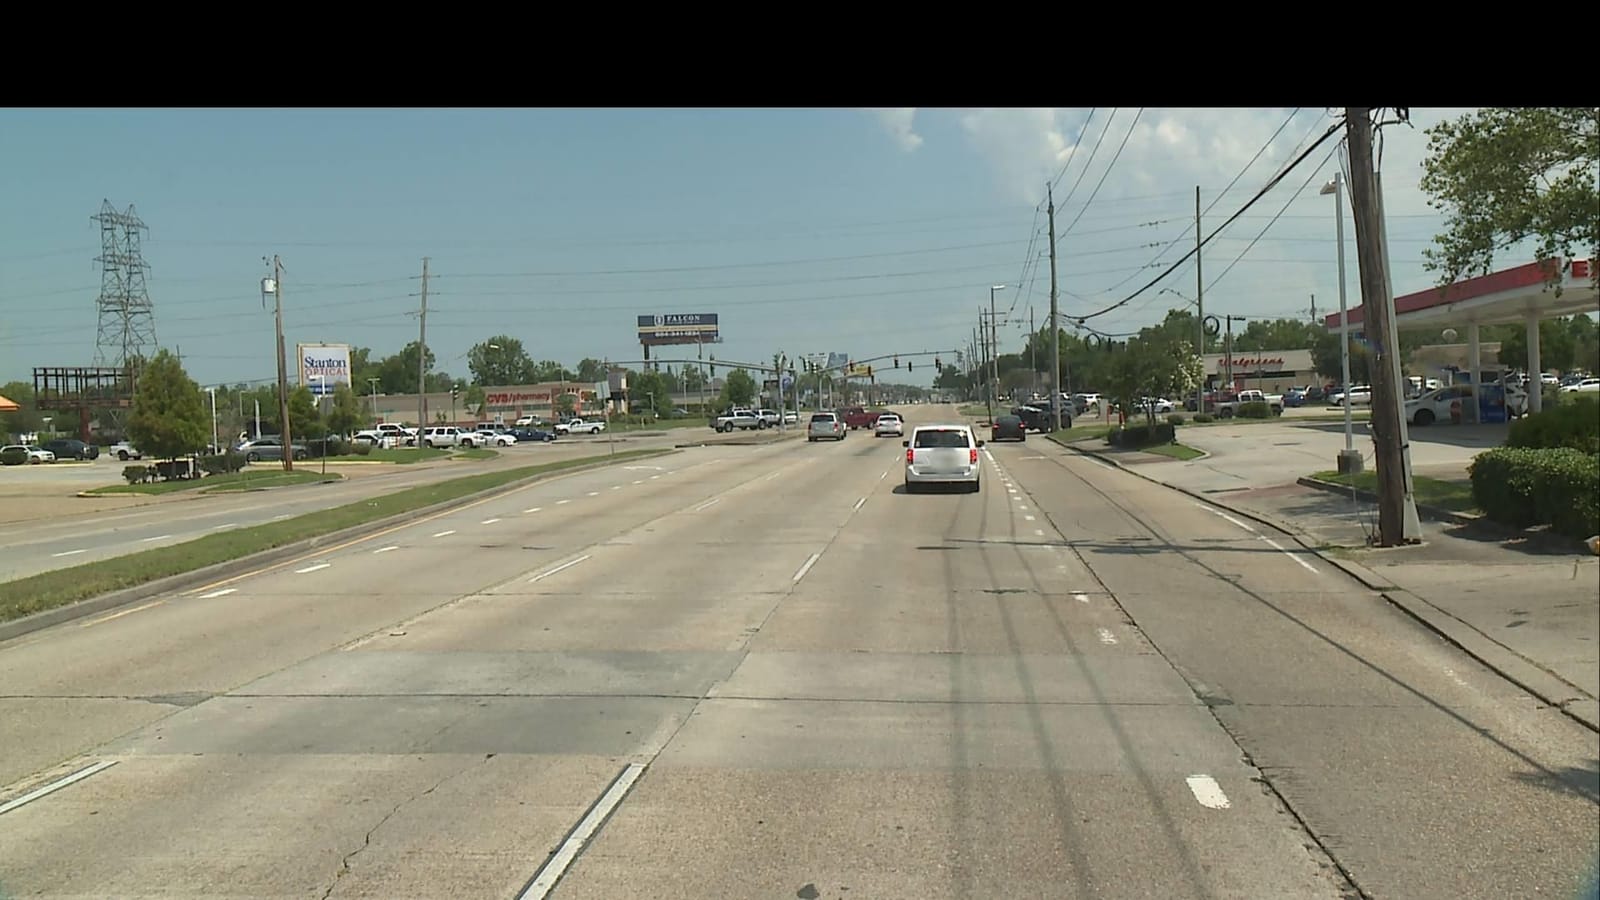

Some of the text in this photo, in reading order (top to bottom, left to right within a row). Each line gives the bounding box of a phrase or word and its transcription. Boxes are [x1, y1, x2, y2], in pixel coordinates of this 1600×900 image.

[304, 356, 346, 368] Stanton
[1218, 357, 1285, 368] Walgreens
[304, 367, 348, 377] OPTICAL
[487, 392, 551, 404] CVS/pharmacy
